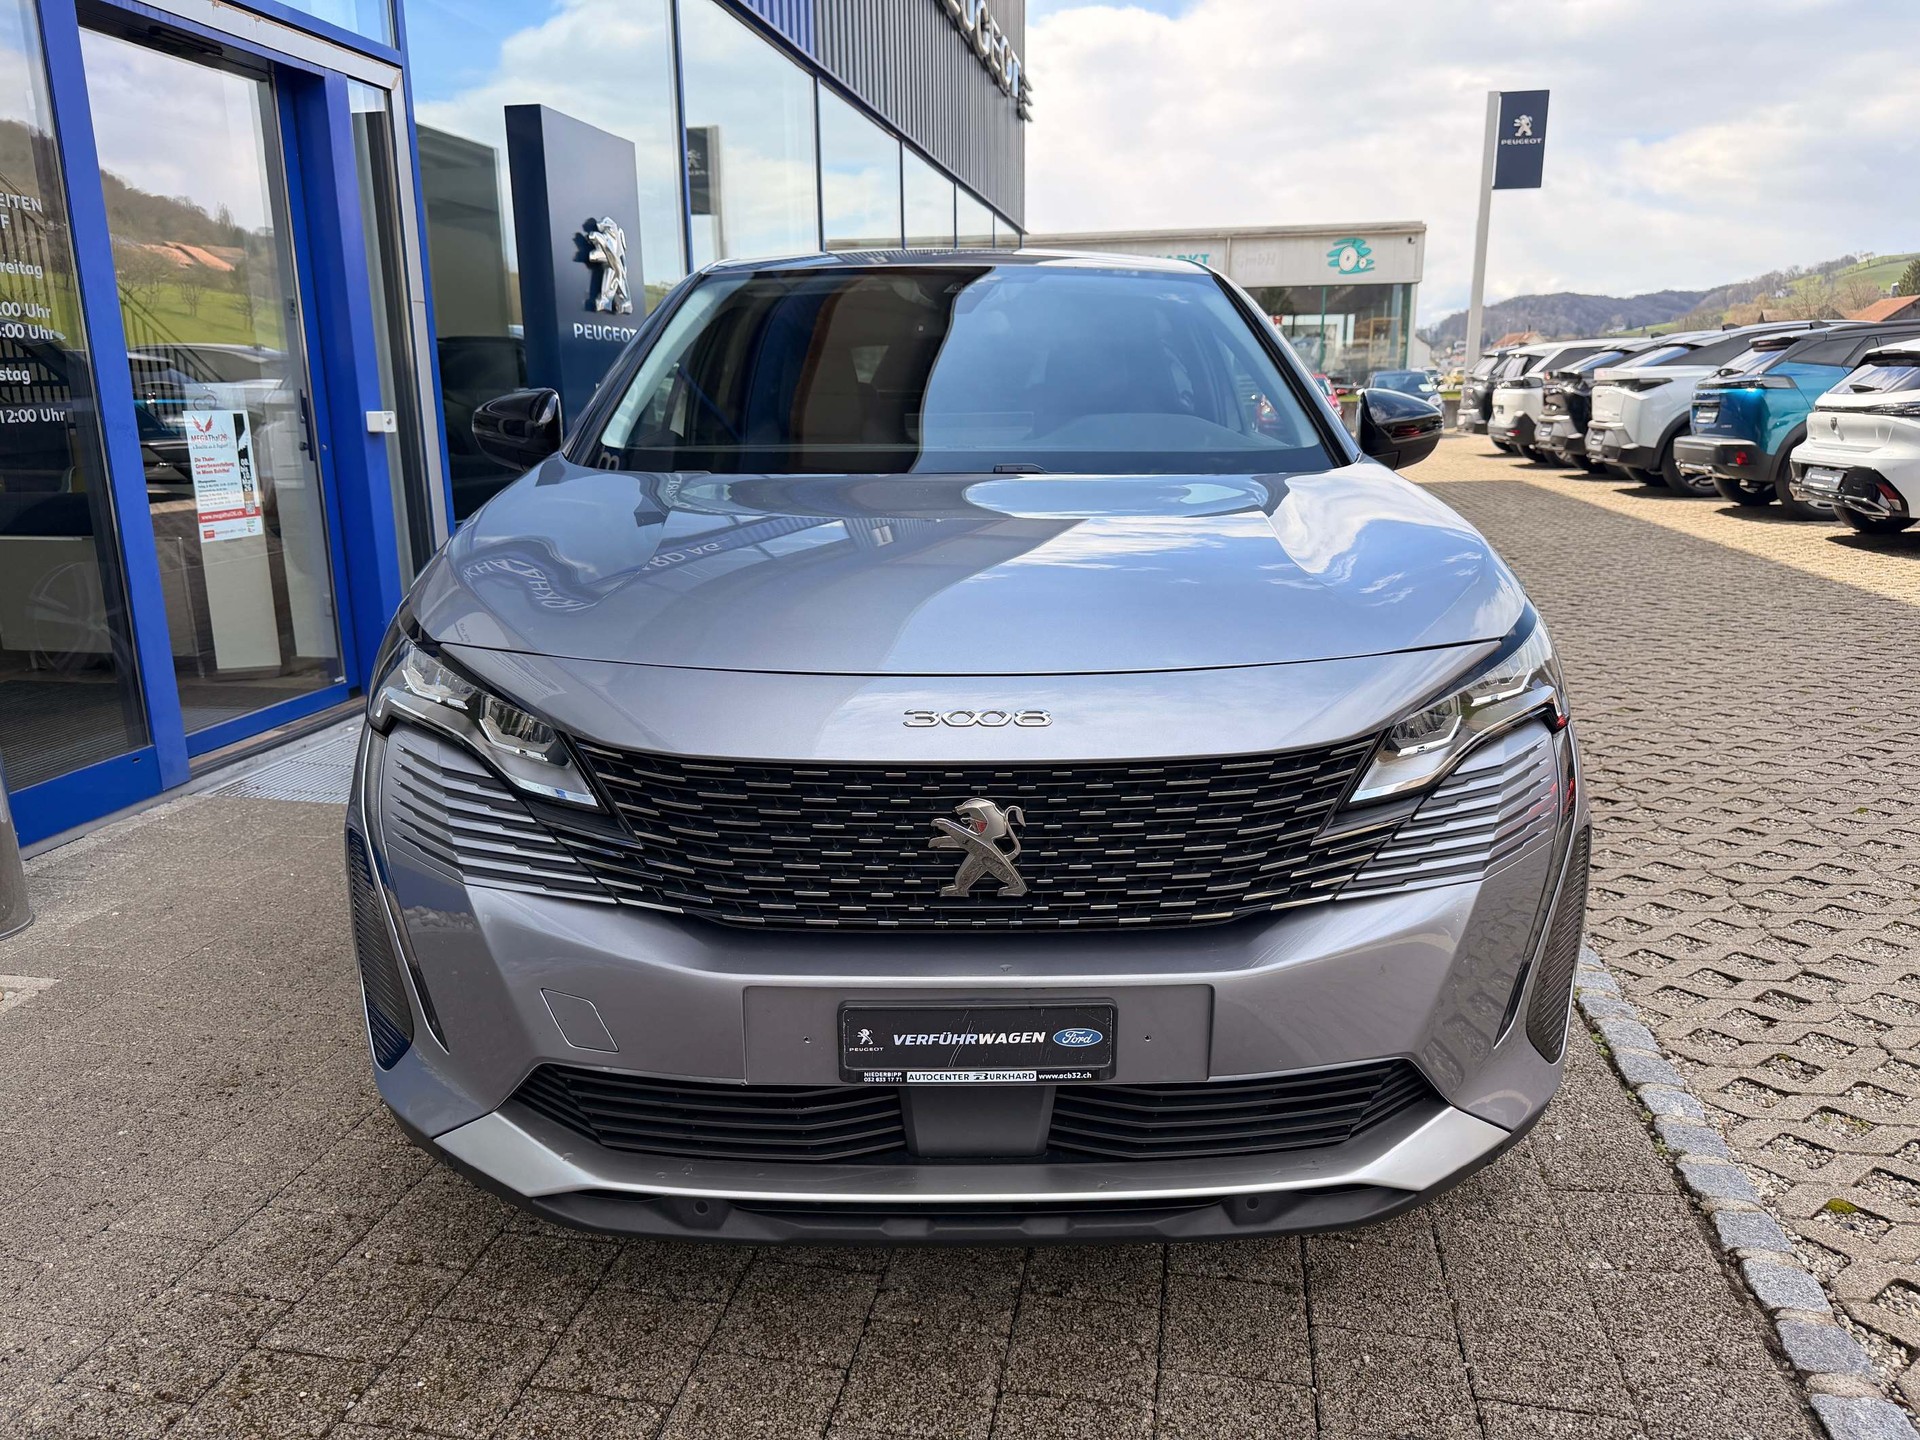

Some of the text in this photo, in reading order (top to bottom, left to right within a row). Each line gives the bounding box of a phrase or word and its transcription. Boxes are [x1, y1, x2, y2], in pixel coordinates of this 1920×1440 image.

[0, 259, 43, 279] reitag
[25, 303, 51, 319] Uhr
[28, 325, 54, 340] Uhr
[573, 323, 637, 343] PEUGEOT
[0, 367, 31, 385] stag
[0, 408, 66, 424] 12:00 Uhr
[903, 709, 1053, 727] 3008
[893, 1031, 1046, 1046] VERFÜHRWAGEN
[1062, 1030, 1093, 1044] Ford
[908, 1073, 970, 1081] AUTOCENTER
